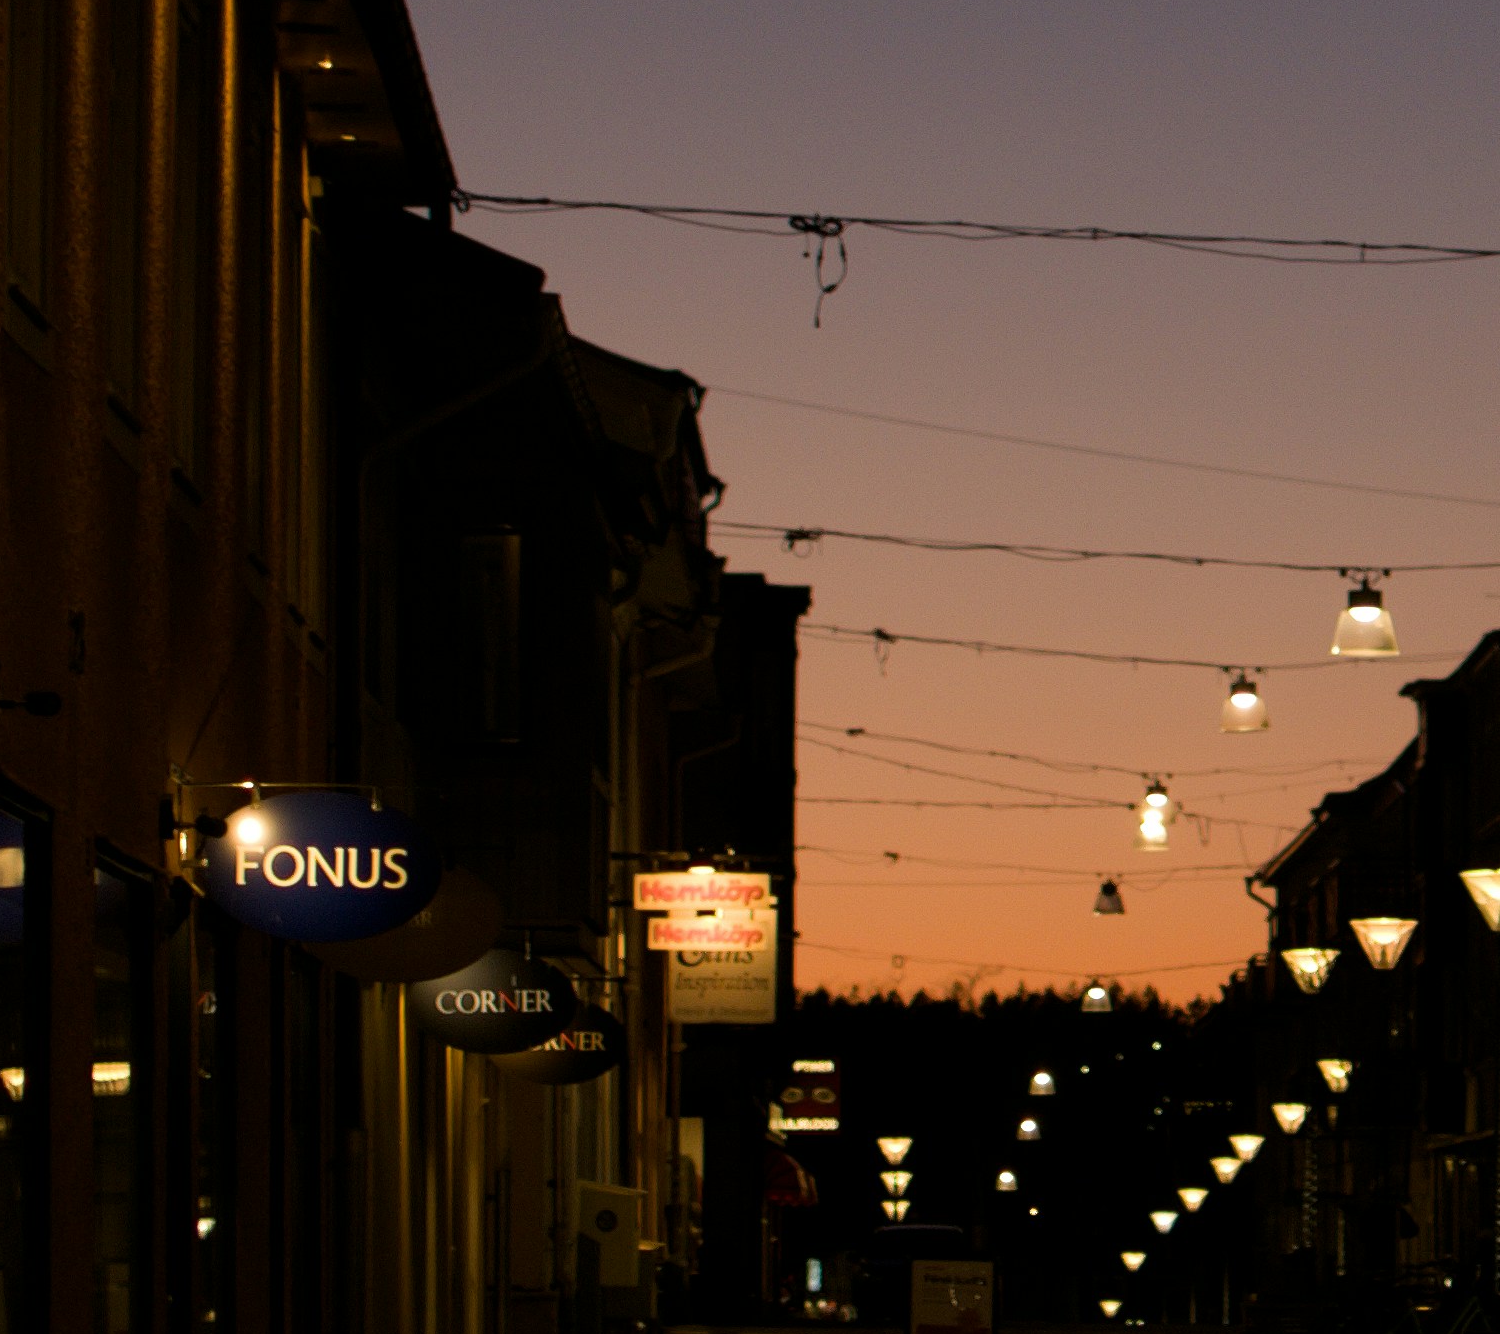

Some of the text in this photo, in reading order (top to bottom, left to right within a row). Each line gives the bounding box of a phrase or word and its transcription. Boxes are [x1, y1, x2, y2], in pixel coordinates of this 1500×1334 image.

[236, 844, 408, 890] FONUS
[640, 879, 765, 906] Hemköp
[653, 923, 764, 948] Hemköp
[675, 972, 769, 998] Inspiration
[435, 988, 554, 1015] CORNER
[530, 1030, 607, 1052] RNER
